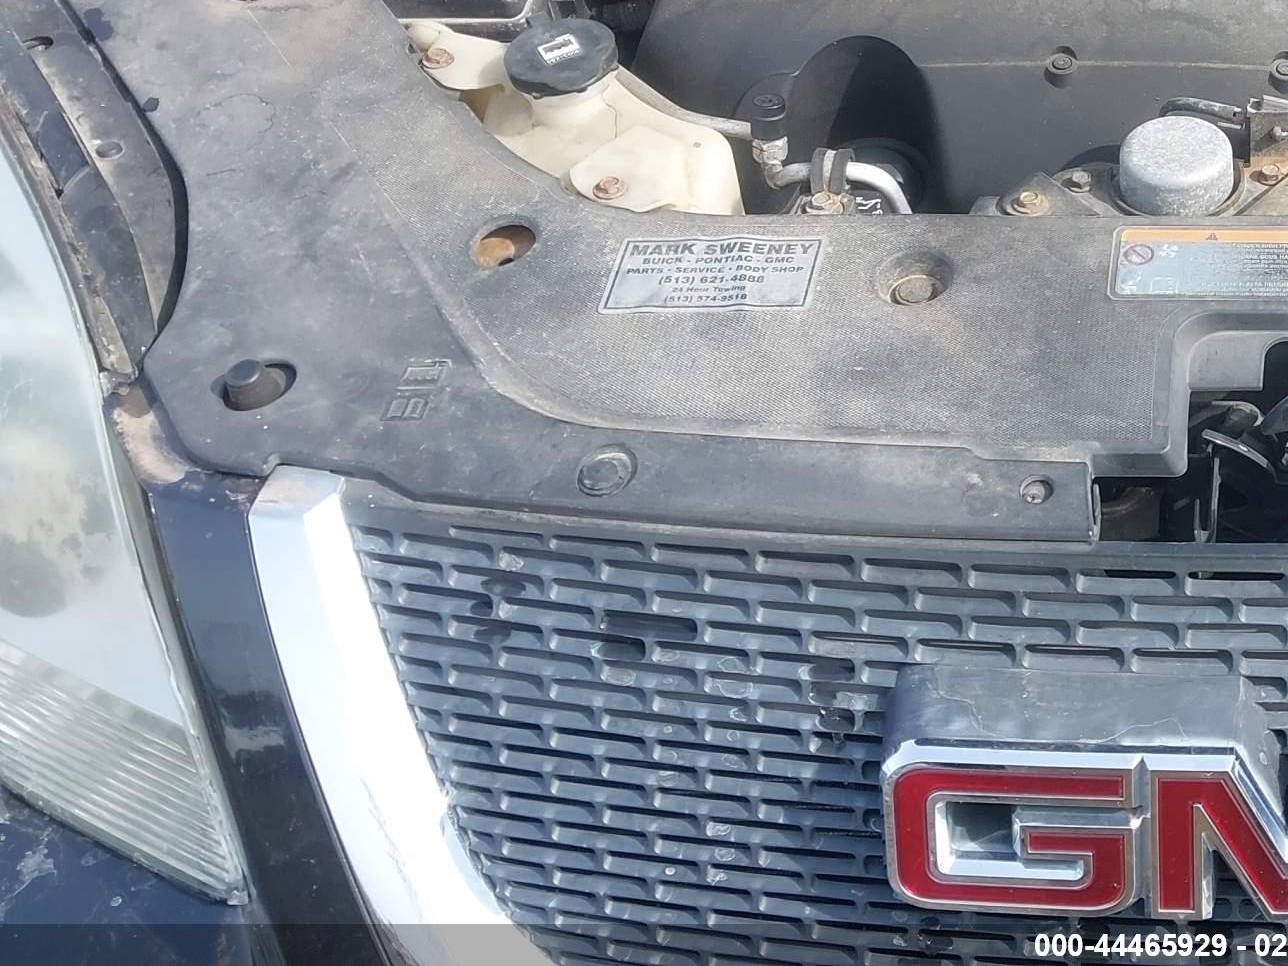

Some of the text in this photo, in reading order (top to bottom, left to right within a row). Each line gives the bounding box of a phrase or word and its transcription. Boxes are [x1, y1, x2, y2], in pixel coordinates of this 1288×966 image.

[630, 241, 815, 256] MARK SWEENEY
[642, 257, 684, 265] BUICK
[695, 255, 753, 264] PONTIAC
[764, 256, 795, 264] GMC
[626, 267, 664, 275] PARTS
[674, 266, 725, 274] SERVICE
[735, 264, 769, 273] BODY
[658, 275, 696, 286] (513)
[713, 285, 746, 293] Towing
[664, 295, 693, 304] (513)
